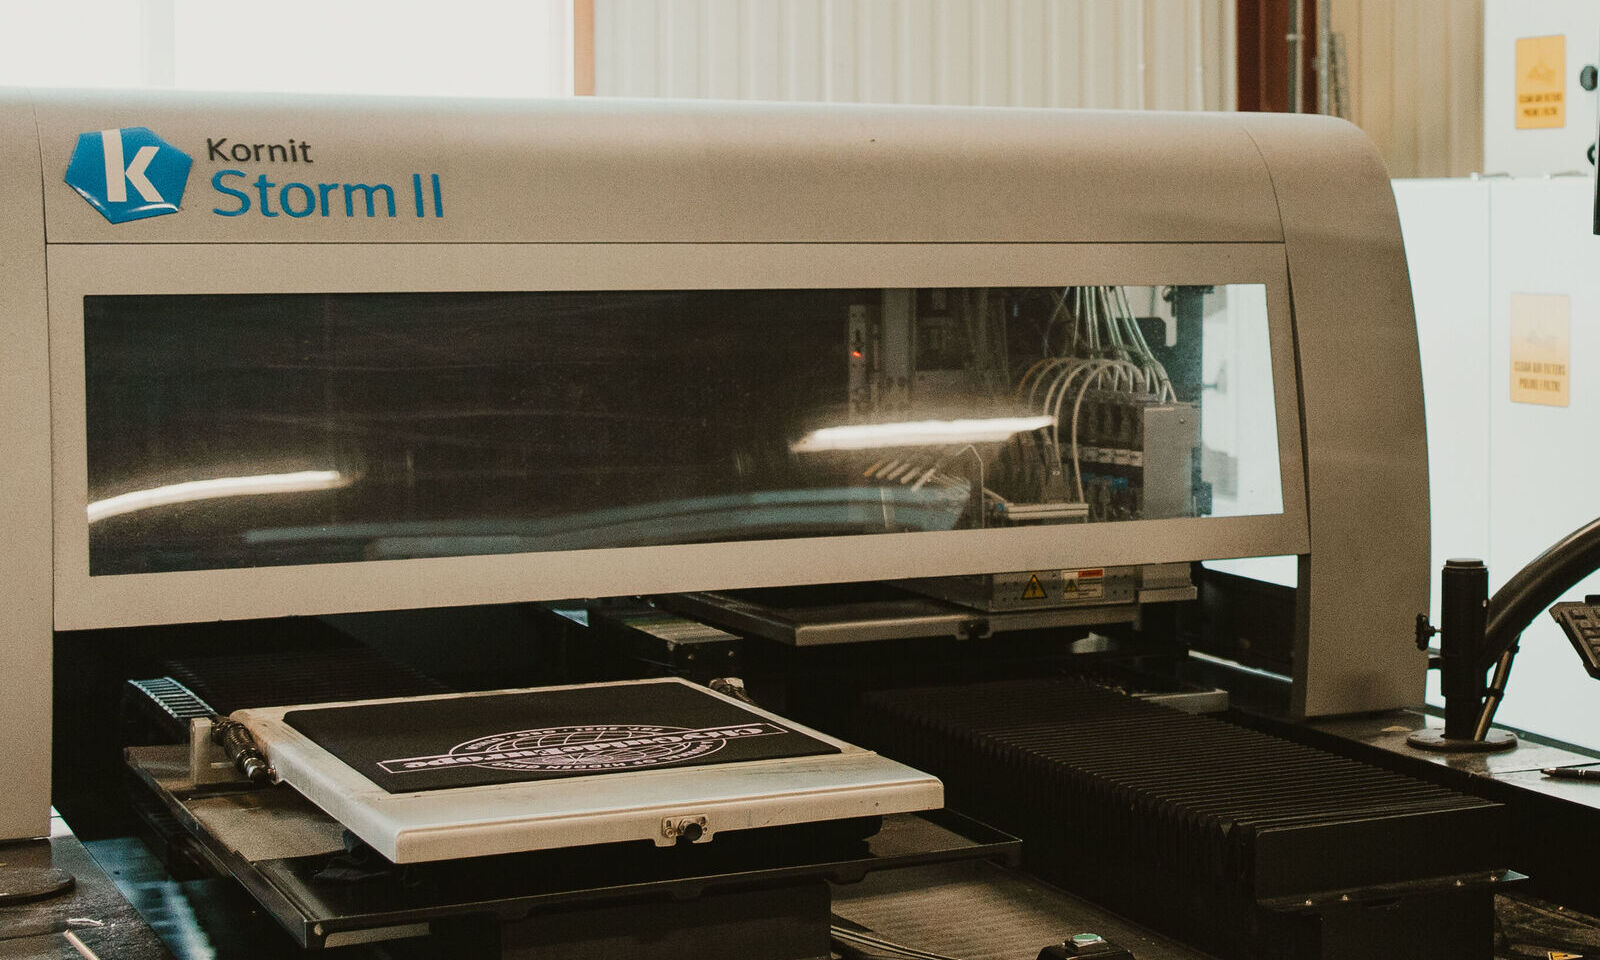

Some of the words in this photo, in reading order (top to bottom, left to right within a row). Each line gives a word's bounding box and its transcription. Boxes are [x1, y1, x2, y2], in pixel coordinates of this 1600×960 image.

[206, 138, 314, 163] Kornit
[211, 169, 396, 218] Storm
[413, 173, 443, 218] II
